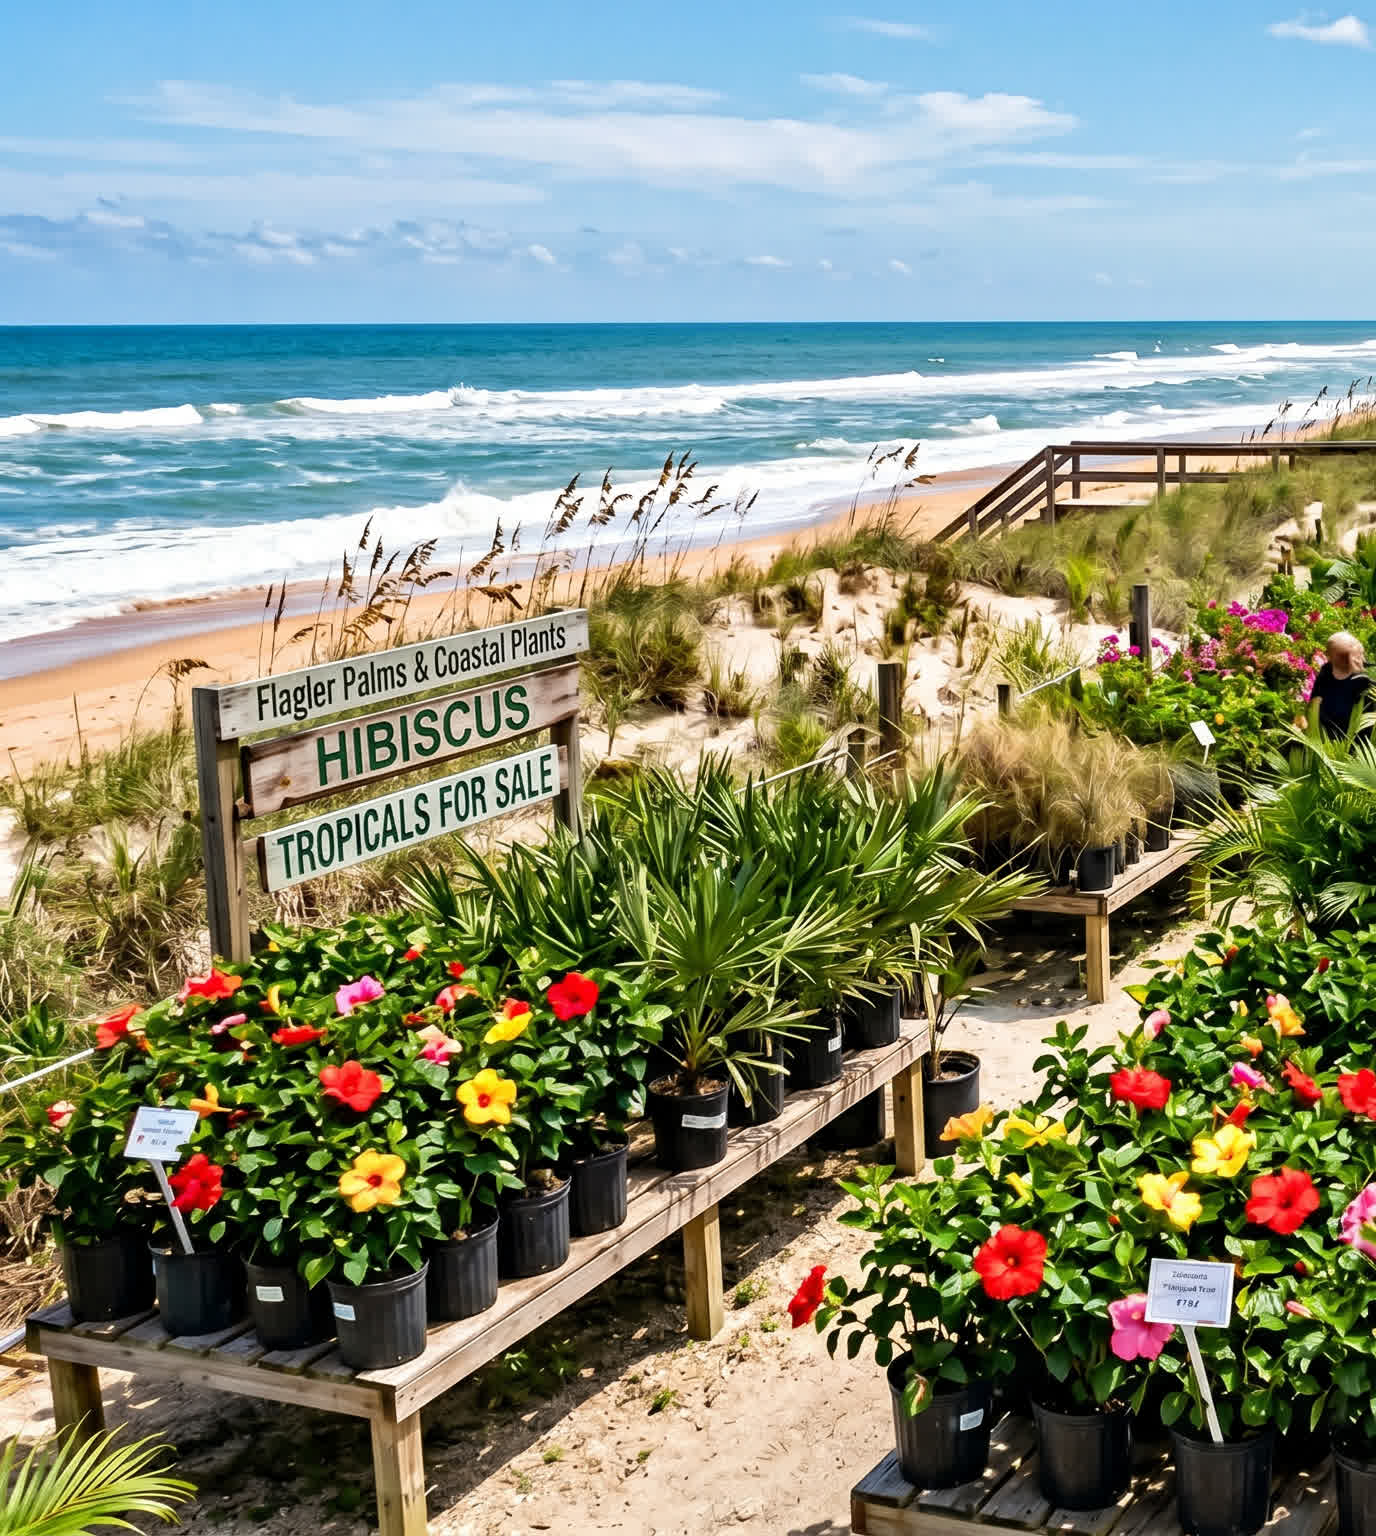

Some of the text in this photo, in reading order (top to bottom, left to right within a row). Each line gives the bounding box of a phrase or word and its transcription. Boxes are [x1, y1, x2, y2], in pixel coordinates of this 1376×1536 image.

[256, 622, 567, 722] Flagler Palms & Coastal Plants
[316, 684, 531, 788] HIBISCUS
[277, 753, 554, 880] TROPICALS FOR SALE
